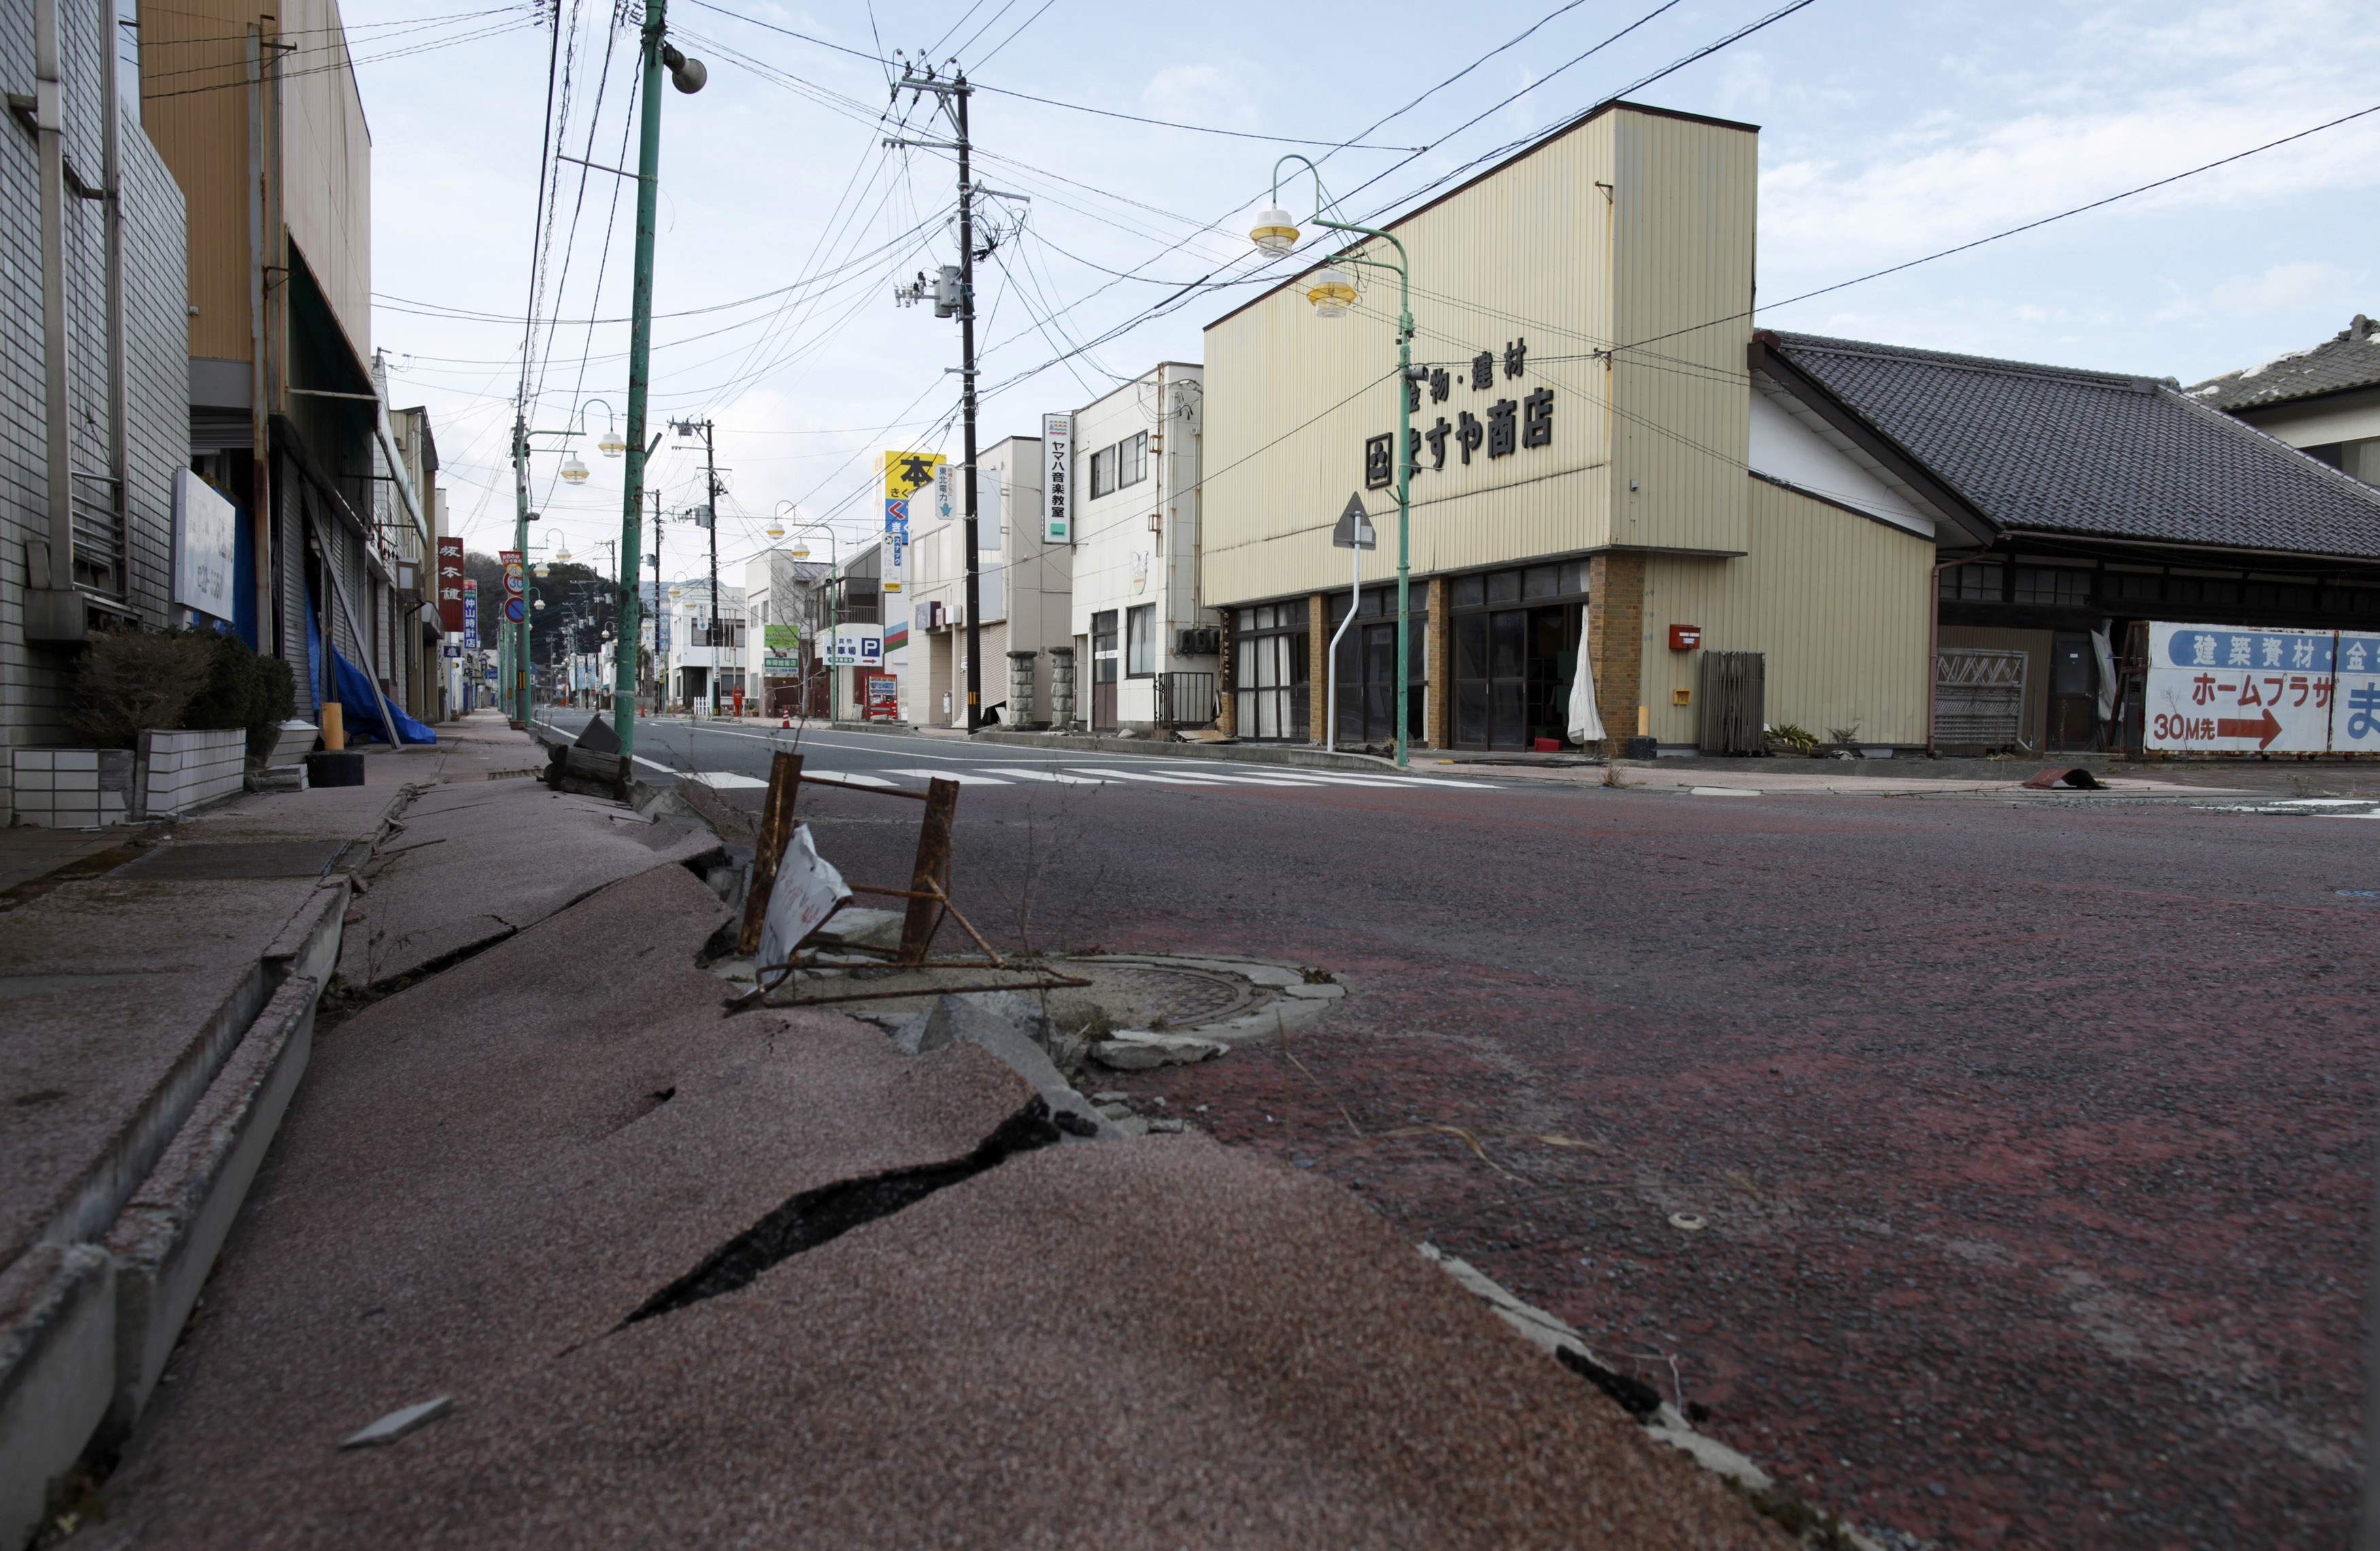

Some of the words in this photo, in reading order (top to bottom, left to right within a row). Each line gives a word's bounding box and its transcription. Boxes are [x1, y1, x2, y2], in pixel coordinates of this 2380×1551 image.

[900, 456, 934, 487] 本
[939, 467, 947, 501] 東北電力
[1051, 441, 1065, 517] ヤマハ音楽教室
[465, 598, 475, 648] 仲山時計店
[2193, 634, 2380, 670] 建築資材・金
[2154, 713, 2215, 740] 30M先
